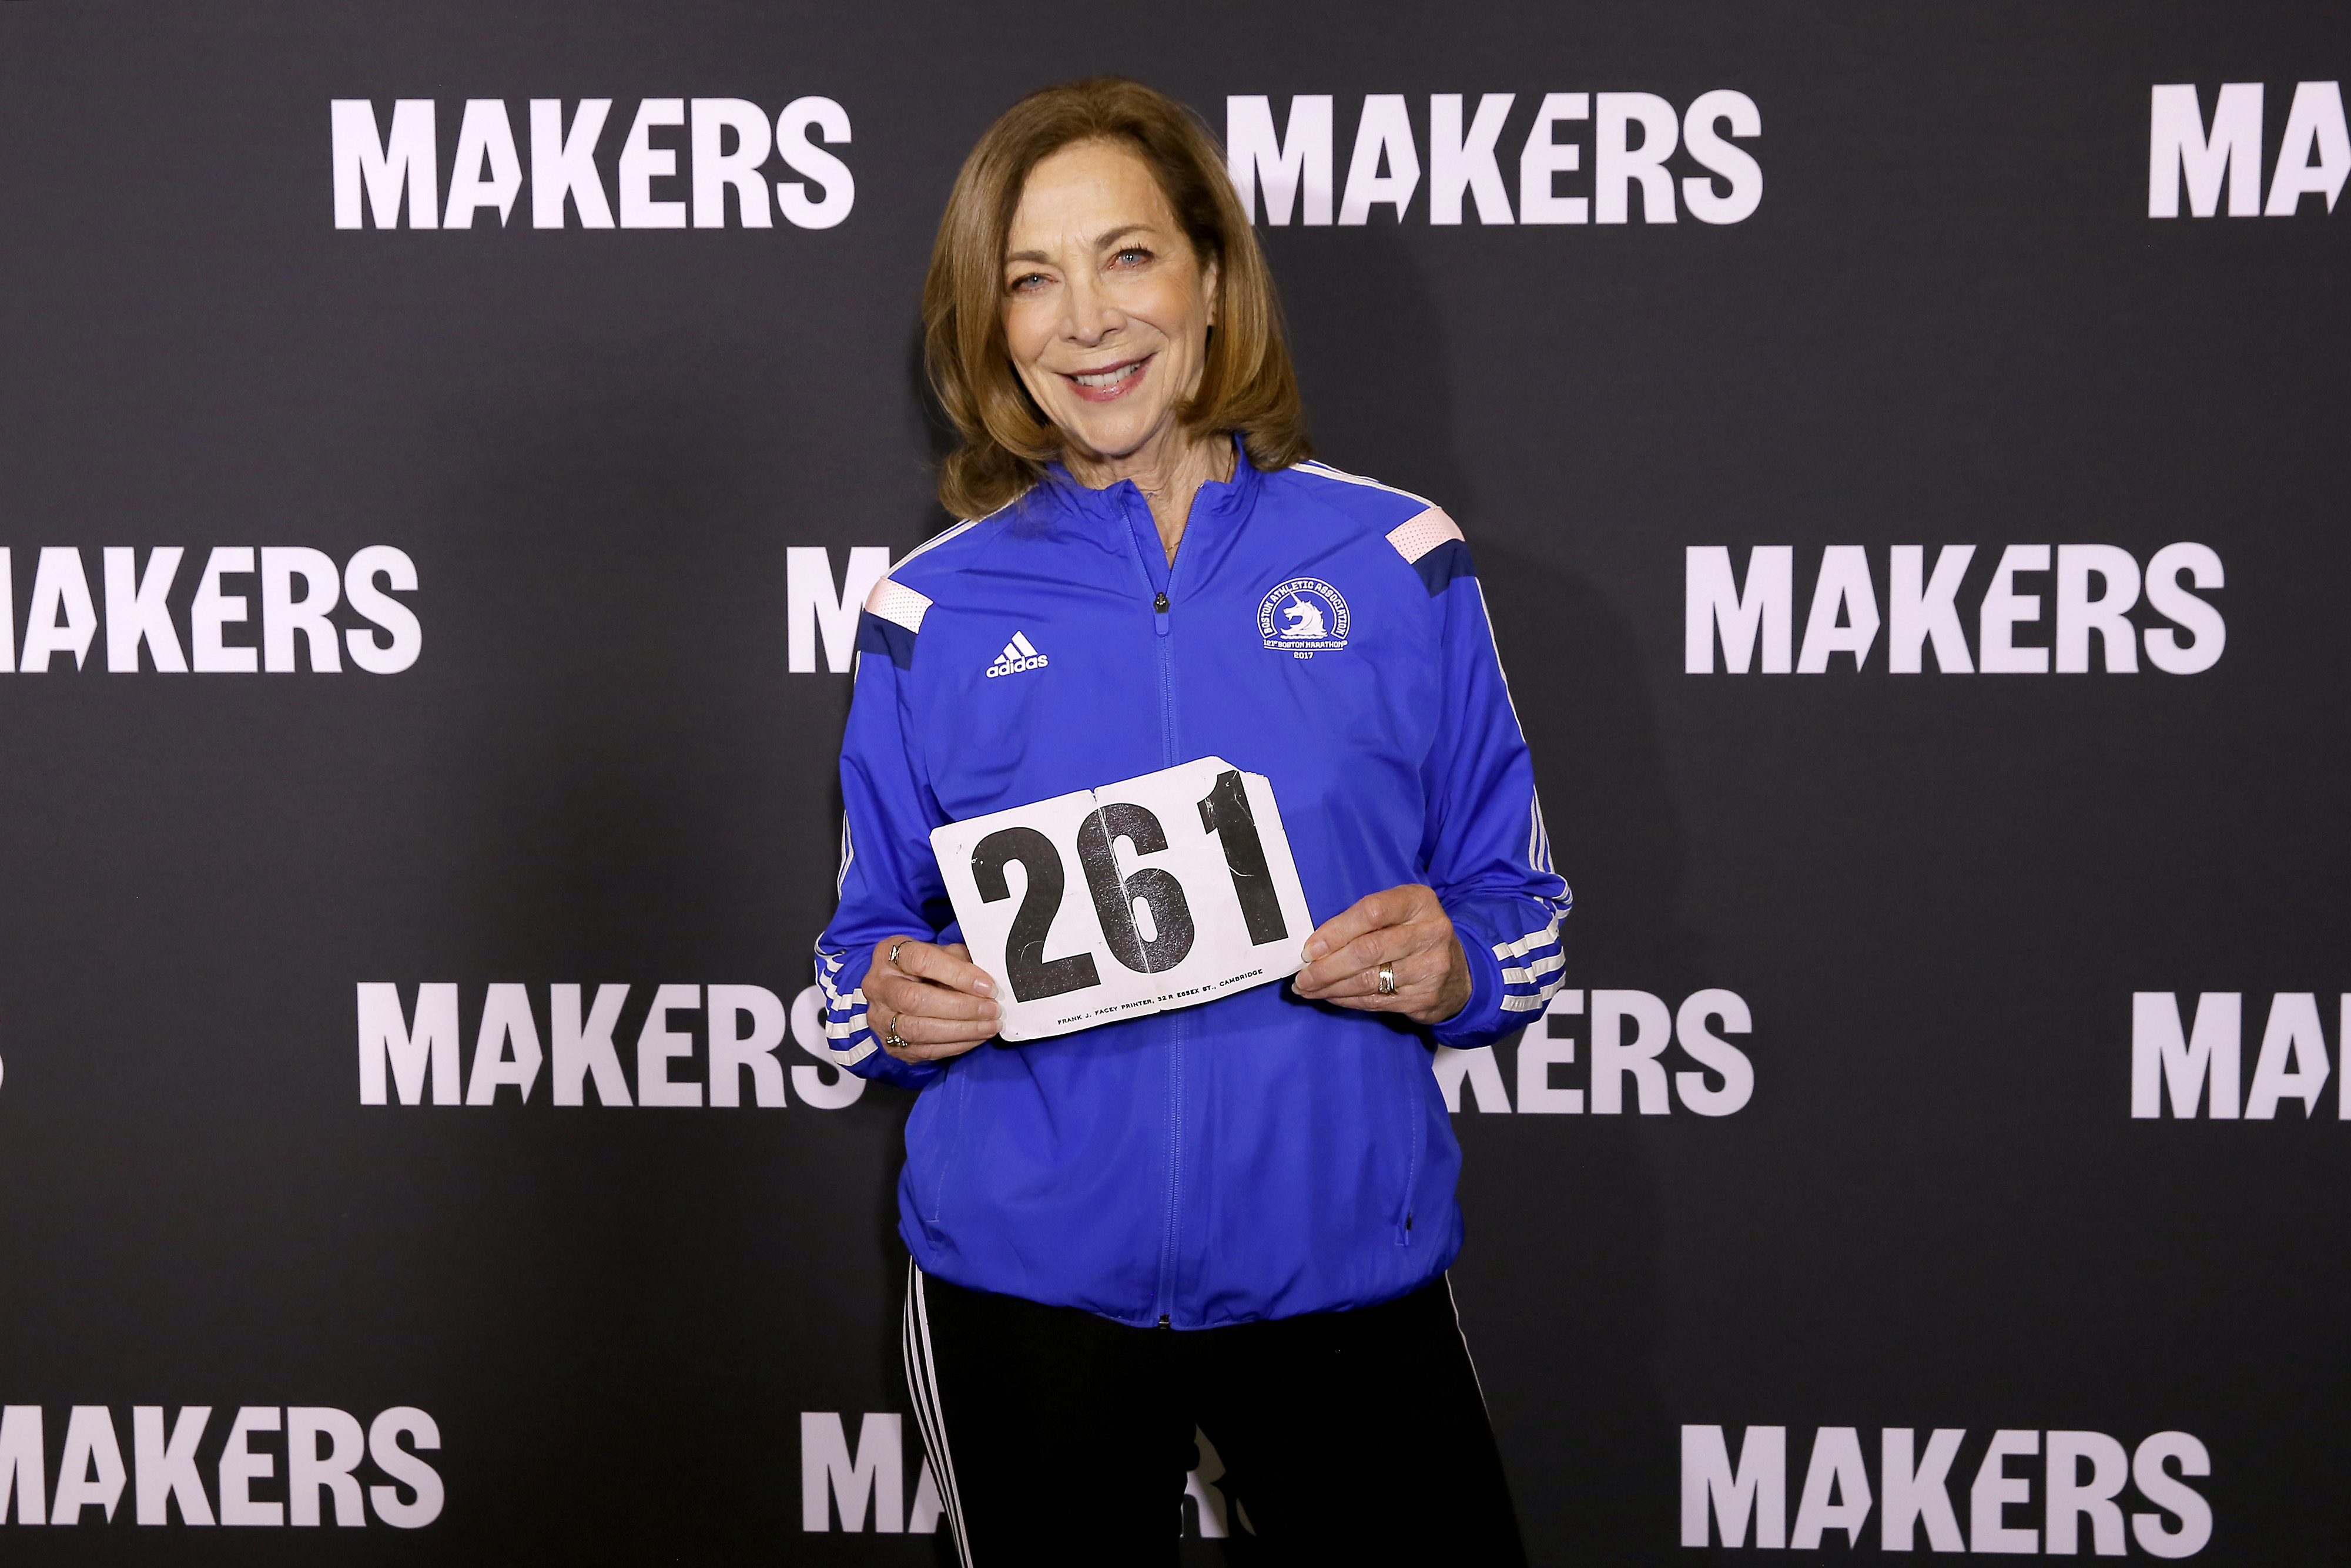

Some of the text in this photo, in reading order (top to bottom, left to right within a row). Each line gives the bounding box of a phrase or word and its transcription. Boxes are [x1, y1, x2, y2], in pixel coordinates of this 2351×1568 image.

[330, 96, 855, 230] MAKERS
[1226, 89, 1763, 226] MAKERS
[0, 544, 422, 675] AKERS
[986, 654, 1049, 678] adidas
[1261, 580, 1348, 636] BOSTON ATHLETIC ASSOCIATION
[1294, 651, 1314, 659] 2017
[1684, 542, 2226, 675] MAKERS
[970, 769, 1290, 1004] 261
[356, 983, 868, 1110] MAKERS
[1057, 1014, 1083, 1025] FRANK
[1121, 998, 1155, 1010] PRINTER,
[1177, 988, 1200, 999] ESSEX
[1219, 969, 1264, 987] CAMBRIDGE
[1681, 1425, 2212, 1559] MAKERS
